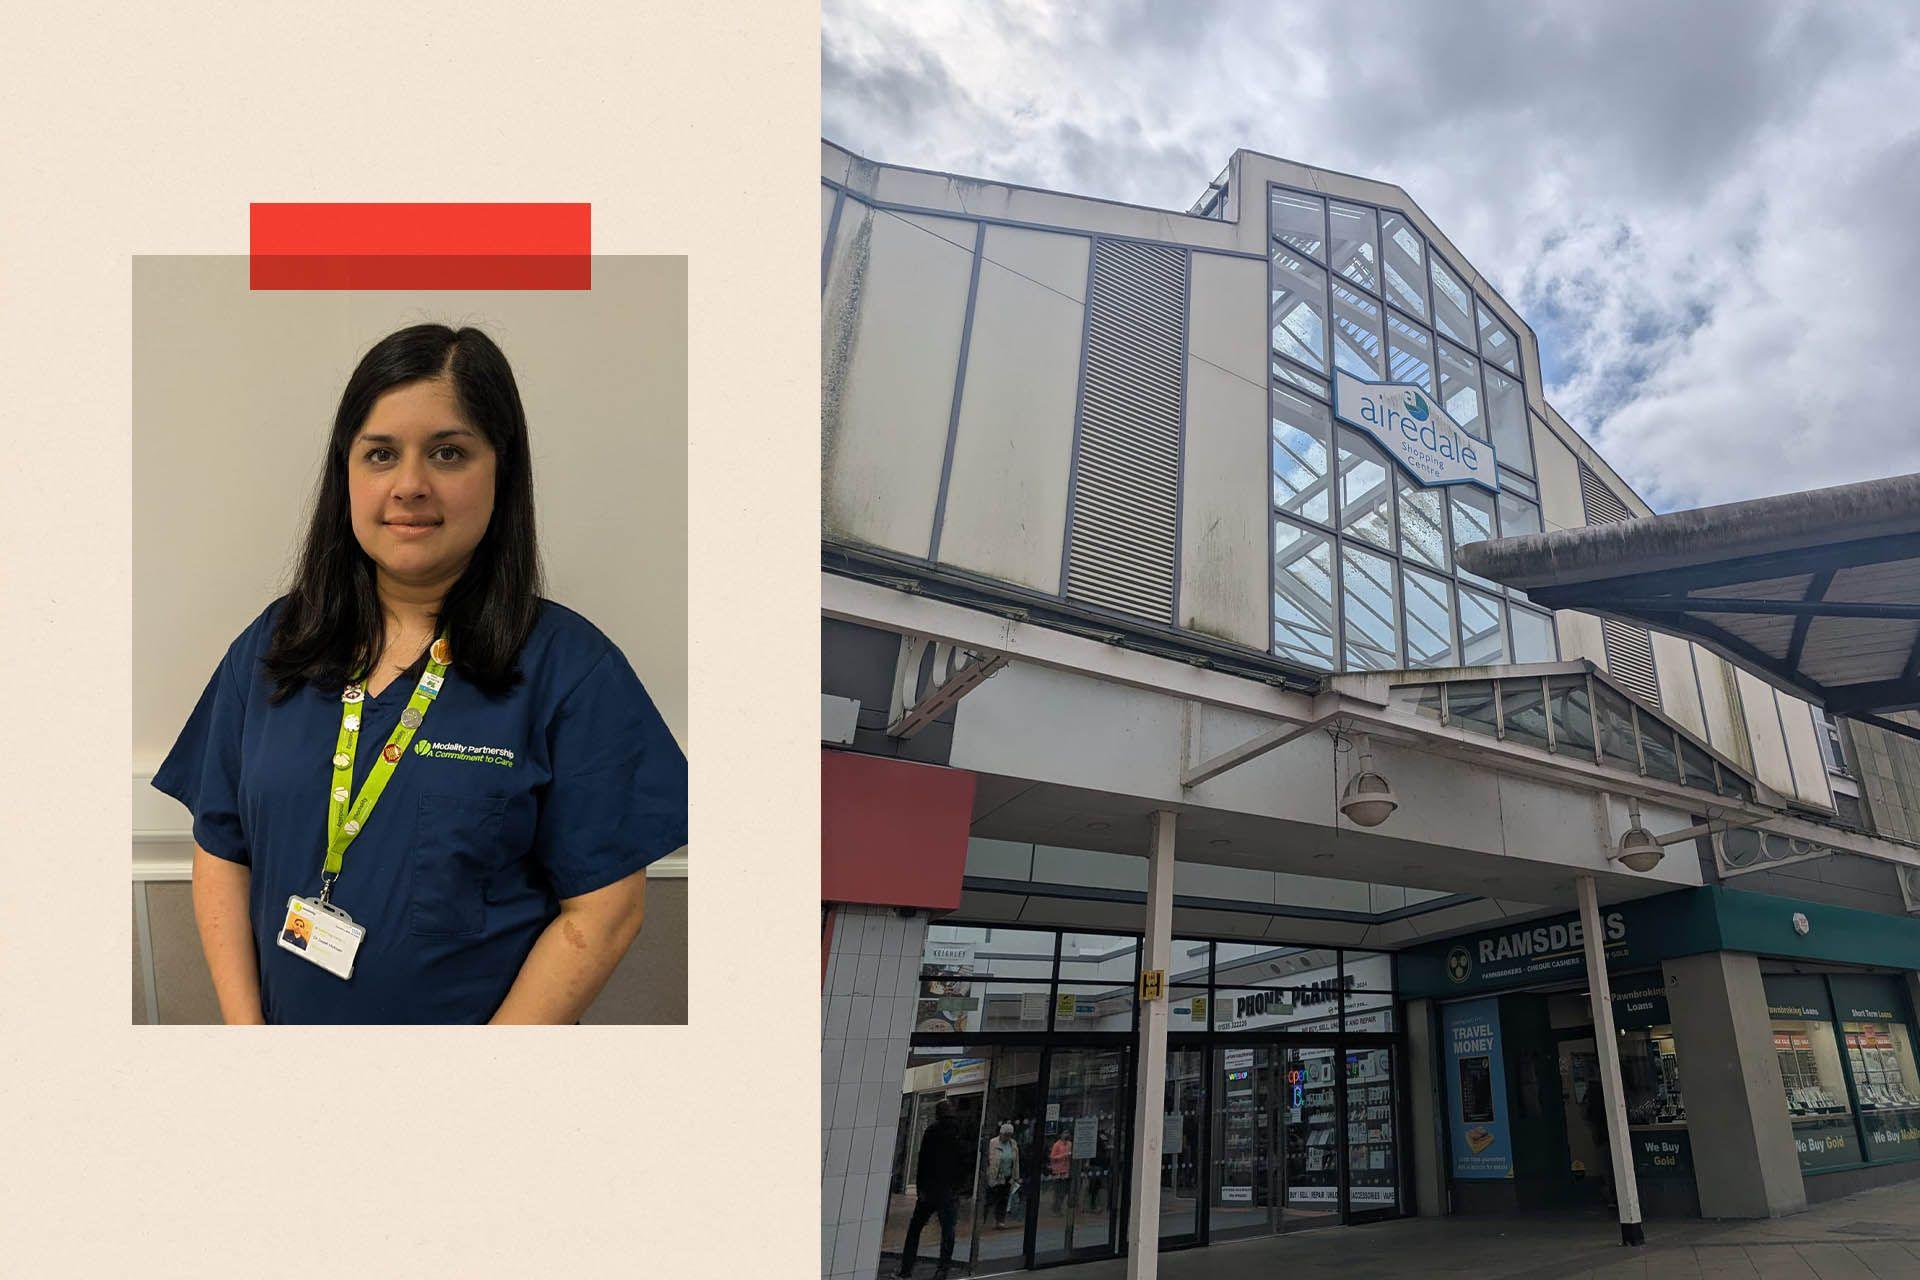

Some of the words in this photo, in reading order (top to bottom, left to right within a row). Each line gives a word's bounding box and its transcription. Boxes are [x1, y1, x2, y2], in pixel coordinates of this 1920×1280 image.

[1361, 394, 1477, 470] airedale
[1402, 441, 1444, 470] Shopping
[1408, 456, 1440, 477] Centre
[432, 743, 467, 753] Modality
[468, 746, 514, 759] Partnership
[435, 751, 484, 763] Commitment
[485, 755, 494, 763] to
[495, 757, 513, 768] Care
[1478, 912, 1626, 964] RAMSDES
[1527, 962, 1551, 973] CHEQUE
[1551, 957, 1579, 969] CASHERS
[1143, 973, 1161, 997] H
[1611, 987, 1665, 1001] Pawnbroking
[1627, 1001, 1653, 1011] Loans
[1769, 1006, 1802, 1016] awnbroking
[1802, 1007, 1819, 1016] Loans
[1852, 1009, 1866, 1017] Short
[1866, 1009, 1878, 1017] Term
[1878, 1010, 1893, 1018] Loans
[1359, 1016, 1377, 1024] REPAIR
[1452, 1024, 1494, 1040] TRAVEL
[1453, 1037, 1494, 1054] MONEY
[1808, 1138, 1824, 1152] Buy
[1826, 1136, 1845, 1149] Gold
[1873, 1131, 1885, 1144] We
[1886, 1130, 1900, 1143] Buy
[1645, 1142, 1660, 1152] We
[1662, 1141, 1680, 1153] Buy
[1654, 1155, 1675, 1166] Gold
[1352, 1191, 1380, 1200] ACCESSORIES
